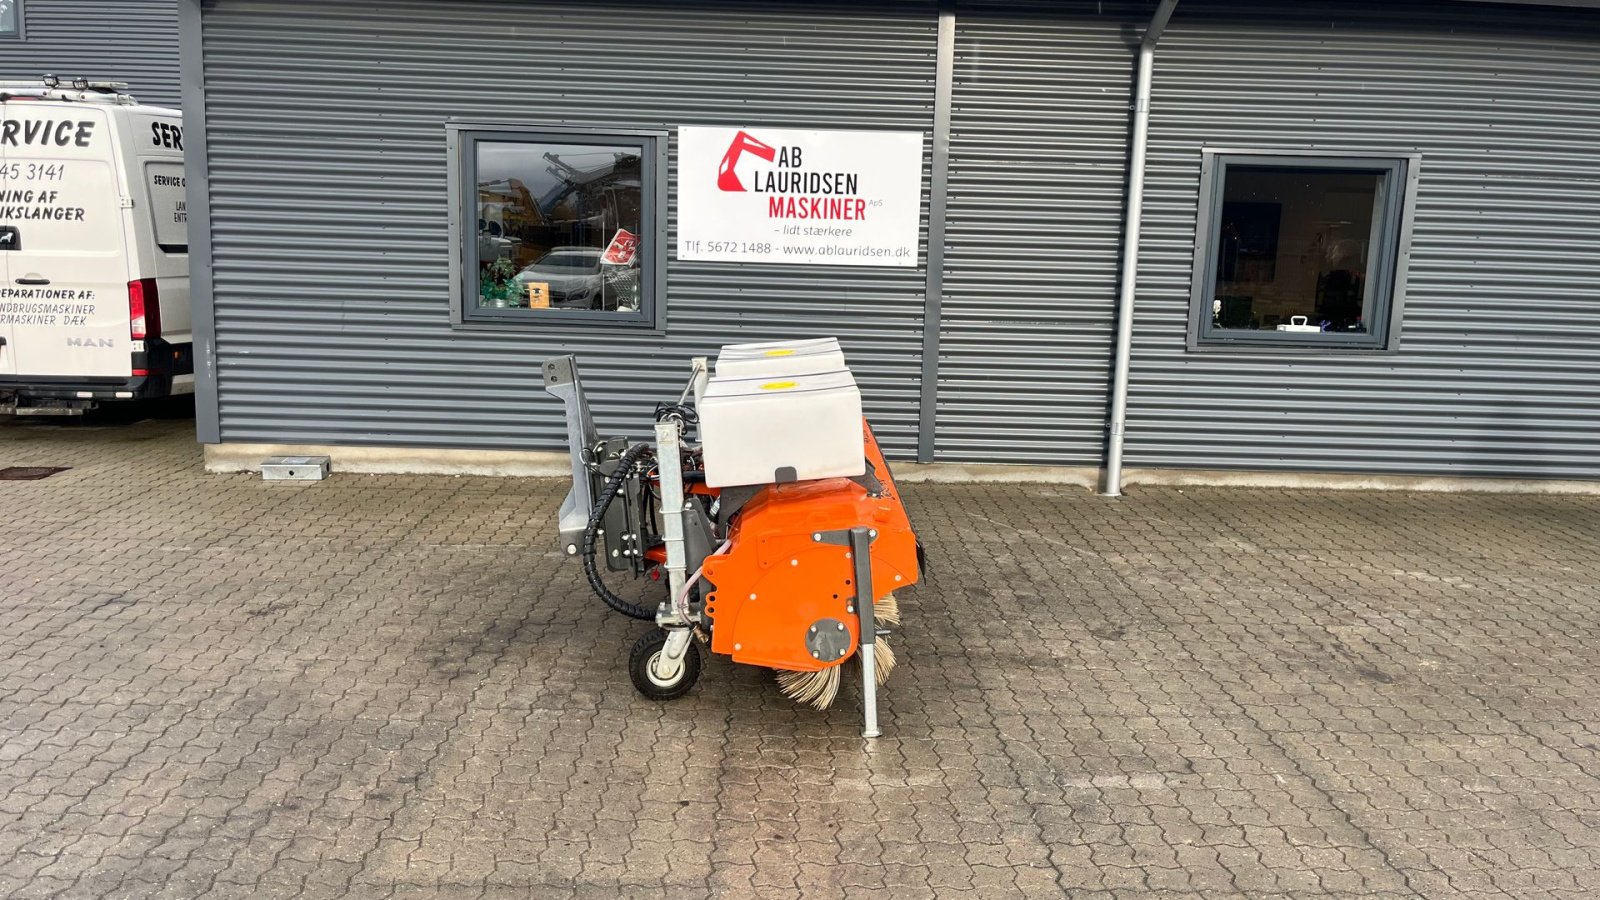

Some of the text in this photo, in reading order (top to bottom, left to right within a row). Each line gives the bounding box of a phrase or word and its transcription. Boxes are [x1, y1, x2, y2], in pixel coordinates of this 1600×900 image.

[0, 119, 95, 147] RVICE
[152, 121, 183, 151] SER
[778, 146, 802, 168] AB
[26, 163, 64, 180] 3141
[154, 175, 180, 187] SERVICE
[754, 170, 858, 195] LAURIDSEN
[38, 191, 58, 203] AF
[768, 196, 866, 221] MASKINER
[783, 225, 801, 236] lidt
[803, 226, 853, 237] stærkere
[685, 241, 703, 254] Tlf.
[707, 241, 738, 253] 5672
[741, 242, 771, 254] 1488
[783, 245, 911, 258] www.ablauridsen.dk
[0, 288, 76, 299] EPARATIONER
[63, 315, 87, 326] DÆK
[67, 337, 114, 348] MAN
